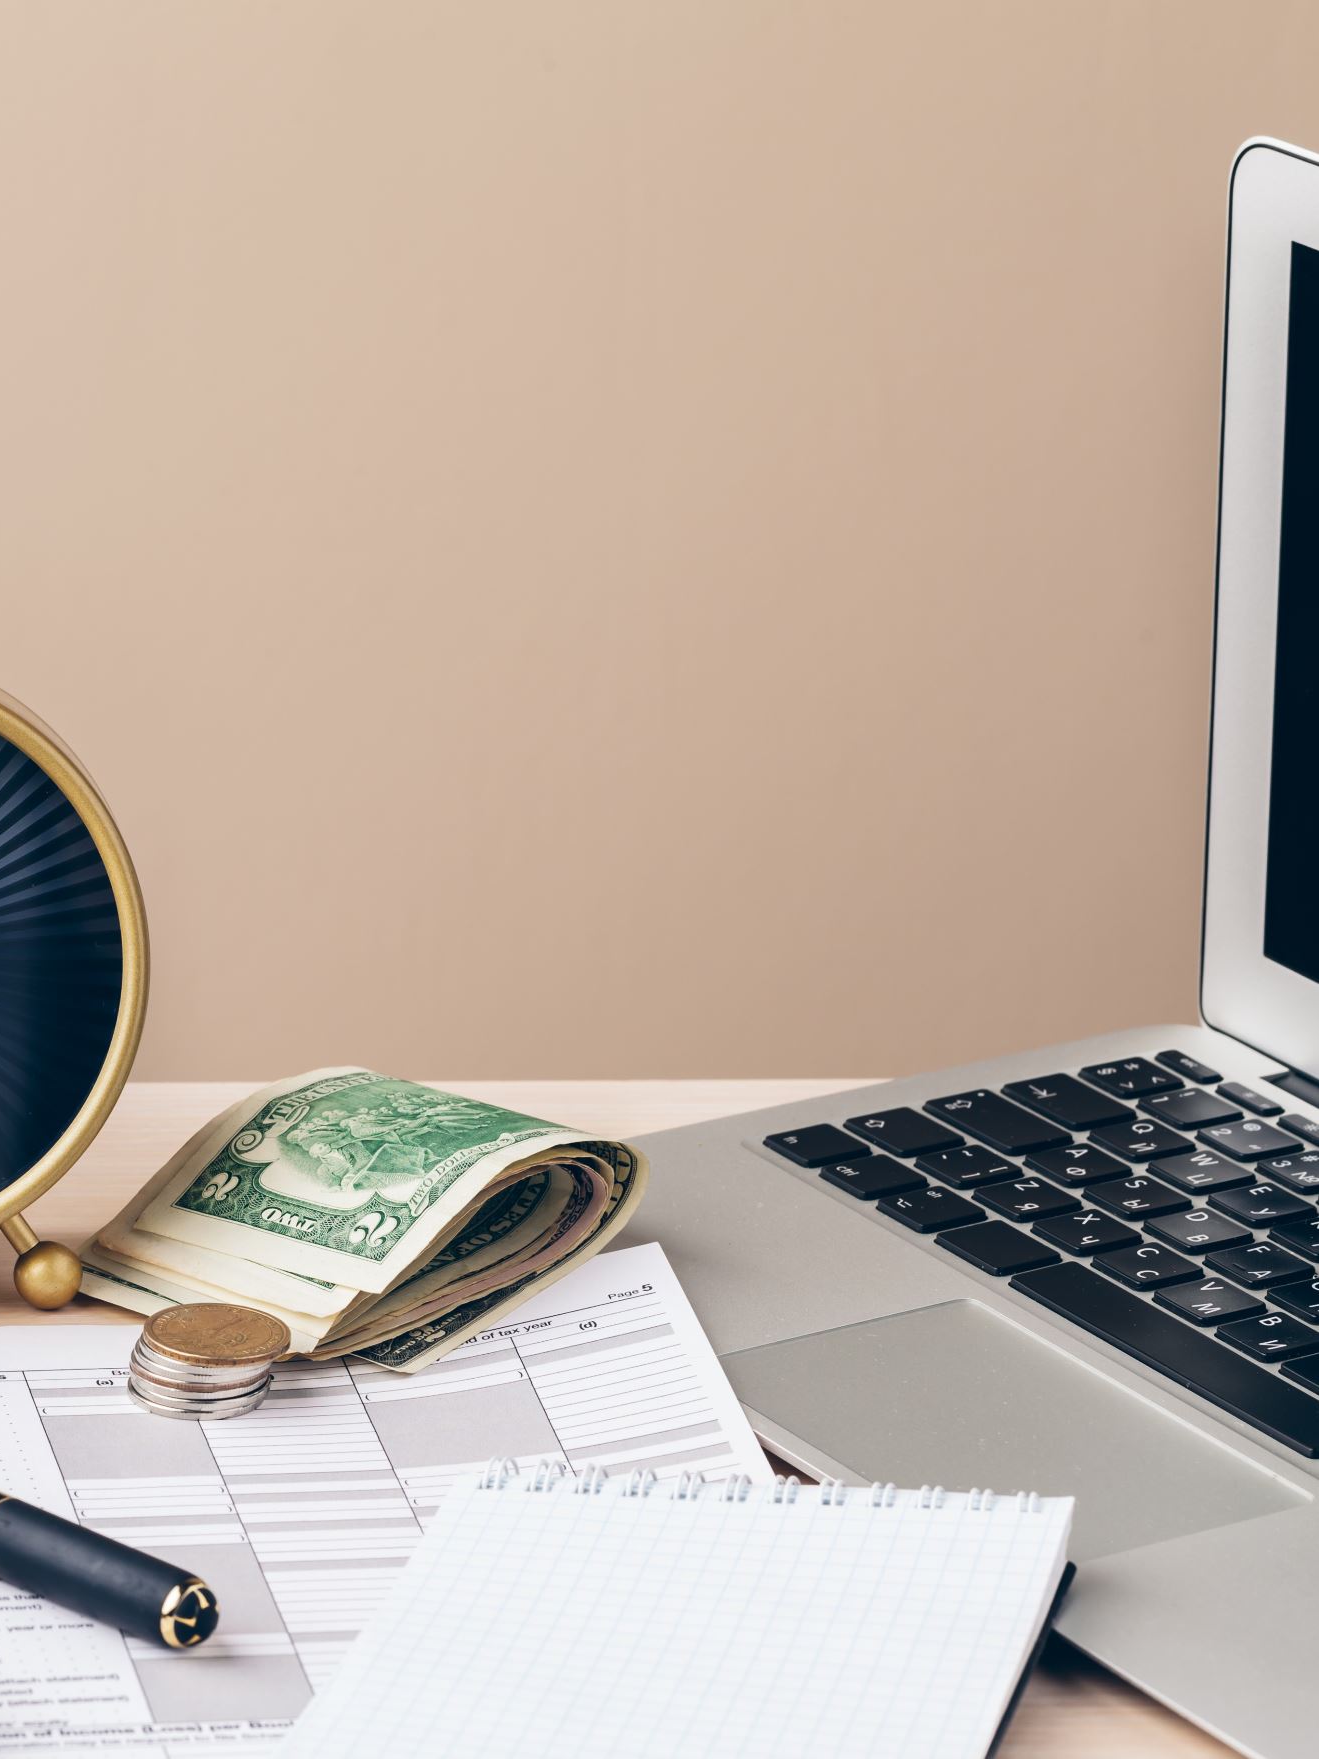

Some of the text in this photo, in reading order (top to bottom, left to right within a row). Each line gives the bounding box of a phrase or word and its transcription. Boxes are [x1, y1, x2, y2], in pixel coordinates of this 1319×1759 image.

[1131, 1122, 1155, 1135] Q
[1210, 1126, 1233, 1138] 2
[1065, 1148, 1089, 1159] A
[1189, 1152, 1220, 1167] W
[1271, 1158, 1292, 1169] 3
[836, 1164, 860, 1178] ctrl
[1013, 1180, 1041, 1192] Z
[1124, 1178, 1149, 1190] S
[1248, 1184, 1273, 1196] E
[1073, 1213, 1101, 1226] X
[1184, 1210, 1210, 1223] D
[1136, 1247, 1161, 1259] C
[1247, 1245, 1272, 1255] F
[607, 1283, 654, 1301] Page 5
[1200, 1281, 1225, 1292] V
[578, 1320, 598, 1331] (d)
[1258, 1315, 1284, 1328] B
[481, 1331, 495, 1341] of
[498, 1326, 520, 1338] tax
[523, 1319, 553, 1335] year
